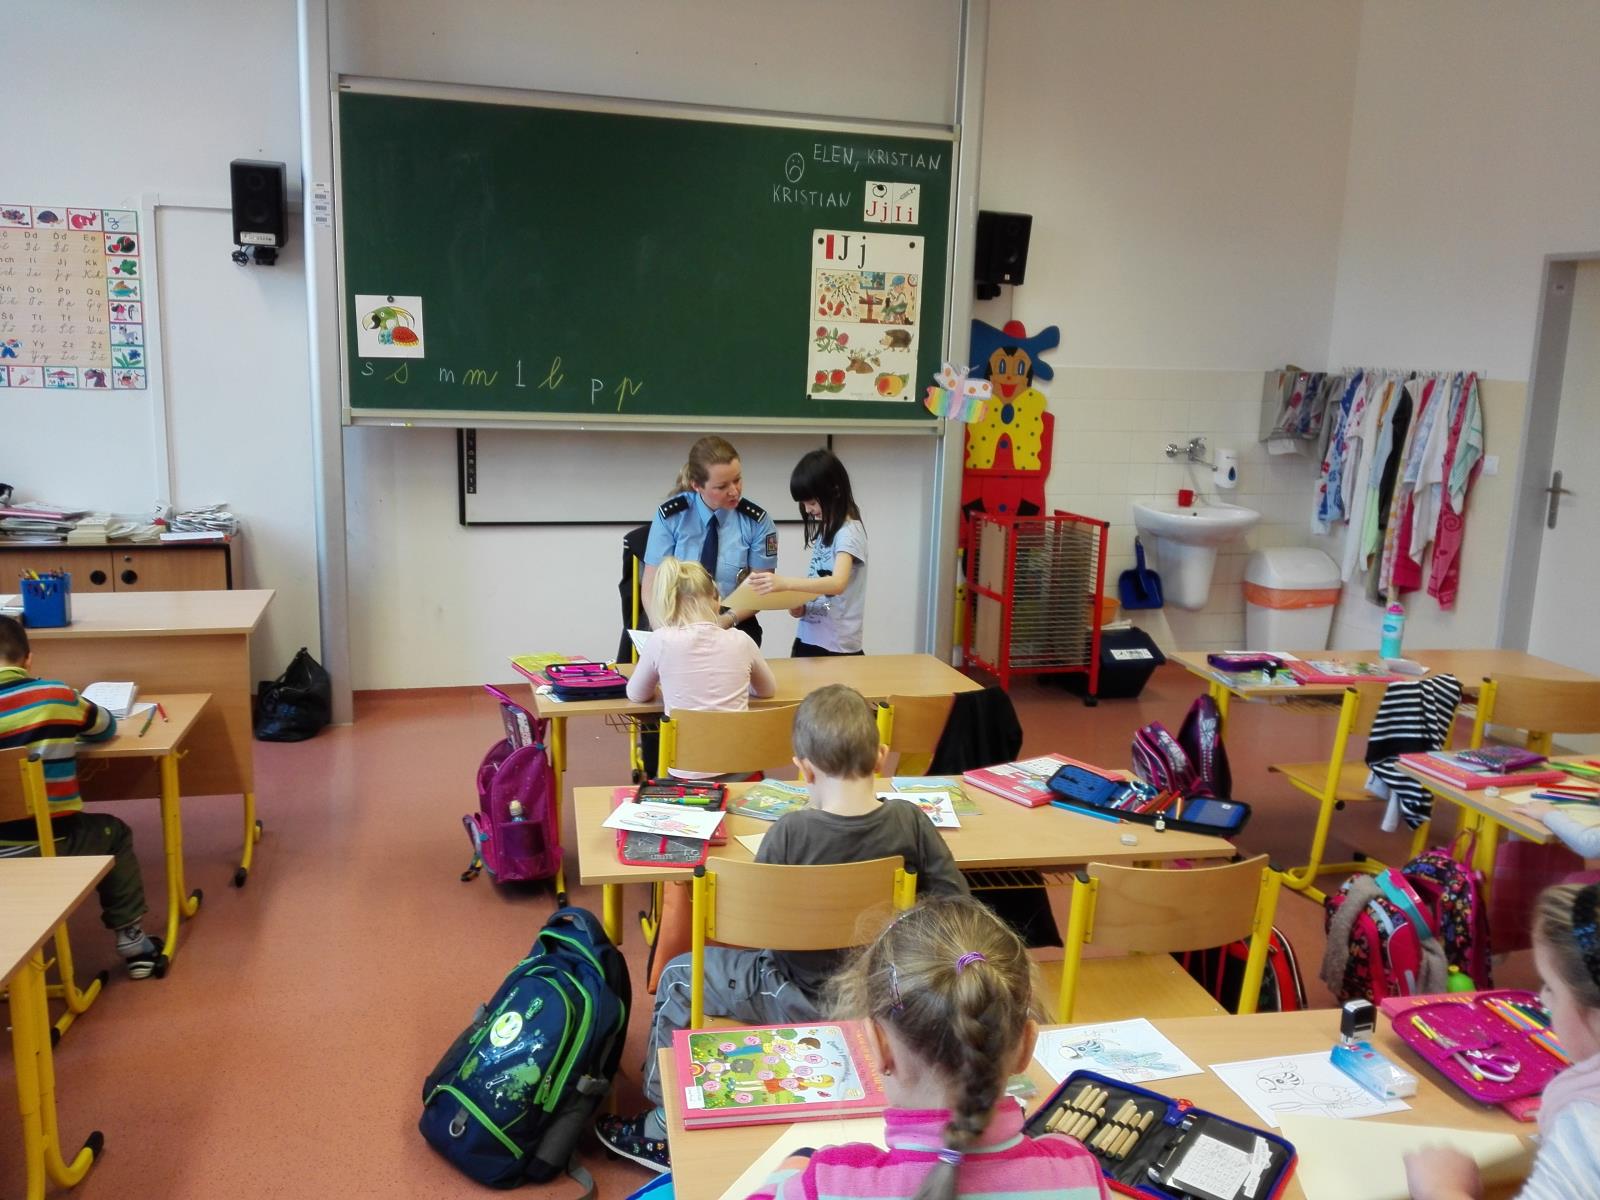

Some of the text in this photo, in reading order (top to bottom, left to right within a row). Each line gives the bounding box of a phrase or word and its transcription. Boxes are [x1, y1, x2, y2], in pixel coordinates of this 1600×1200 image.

[813, 143, 942, 172] ELEN, KRISTIAN
[773, 184, 852, 207] KRISTIAN
